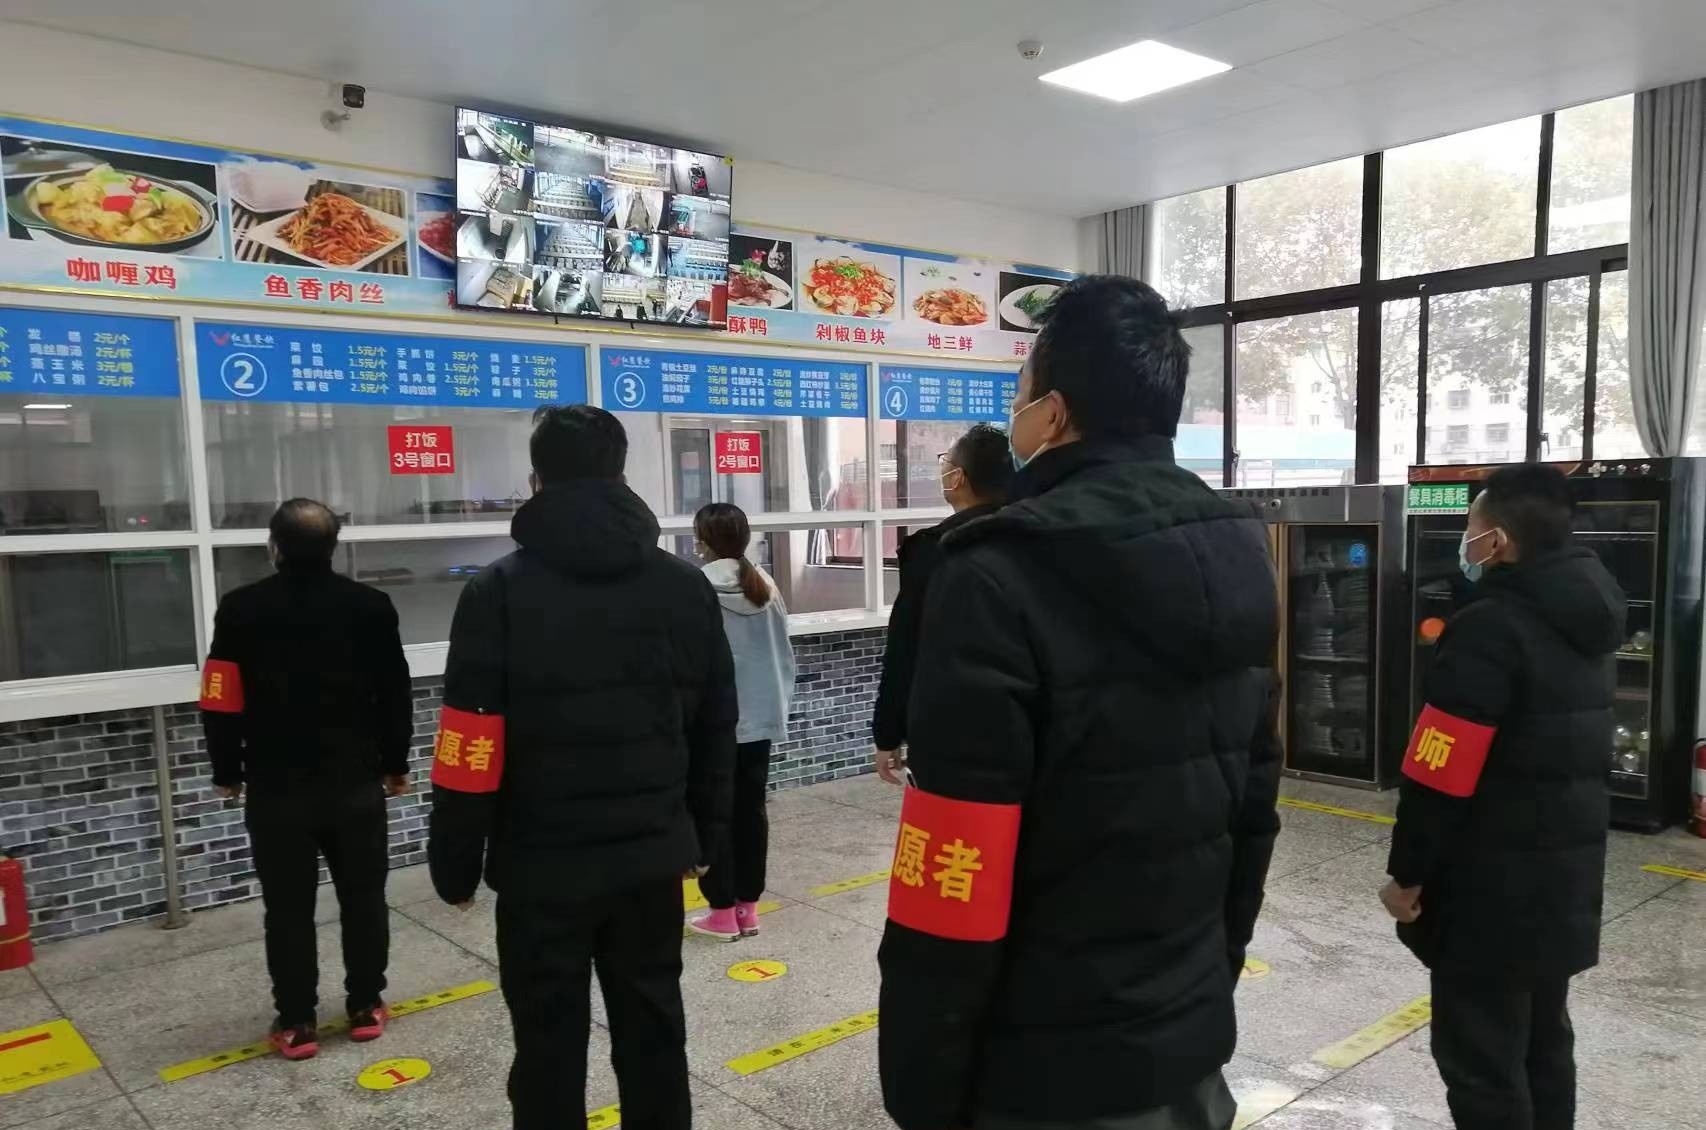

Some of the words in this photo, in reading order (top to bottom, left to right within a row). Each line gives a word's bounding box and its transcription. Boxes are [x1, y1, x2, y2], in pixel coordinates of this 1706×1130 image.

[66, 257, 176, 289] 咖喱鸡
[264, 274, 384, 304] 鱼香肉丝
[816, 323, 885, 345] 剁椒鱼块
[927, 334, 973, 351] 地三鲜
[348, 346, 387, 357] 1.5元/个
[452, 351, 479, 362] 3元/个
[233, 360, 255, 390] 2
[351, 371, 388, 381] 1.5元/个
[623, 378, 637, 402] 3
[890, 392, 902, 412] 4
[405, 431, 438, 448] 打饭
[727, 437, 750, 451] 打饭
[393, 451, 451, 468] 3号窗口
[718, 454, 760, 468] 2号窗口
[1414, 726, 1456, 771] 师
[894, 822, 983, 902] 愿者
